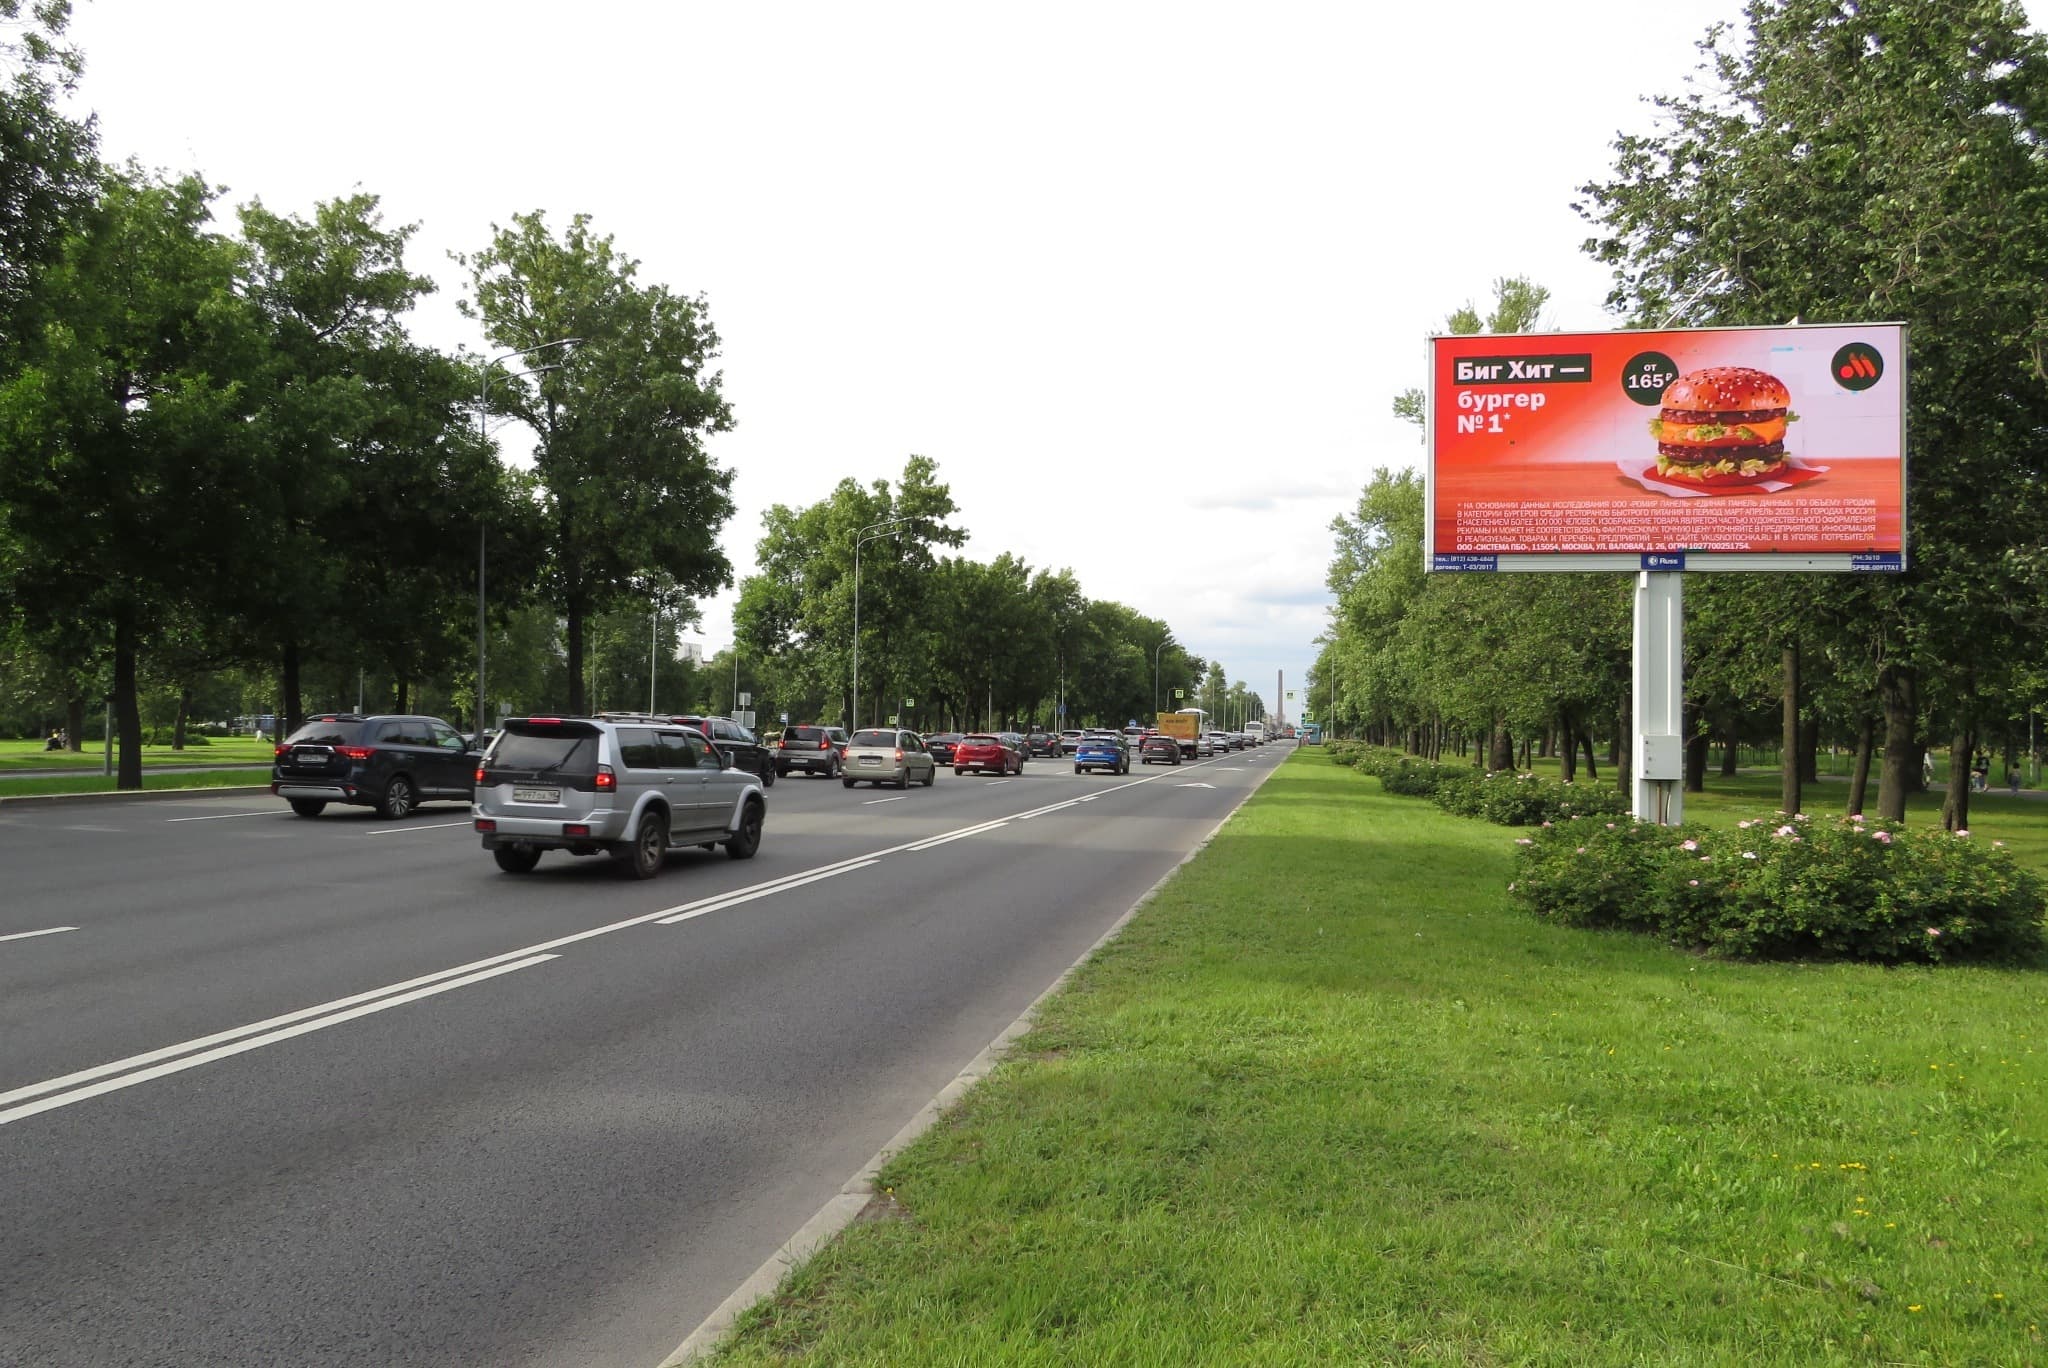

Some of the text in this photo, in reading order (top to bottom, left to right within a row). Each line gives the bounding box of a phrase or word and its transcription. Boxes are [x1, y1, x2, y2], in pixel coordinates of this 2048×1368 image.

[1457, 361, 1503, 380] Биг
[1507, 360, 1555, 379] Хит
[1643, 363, 1658, 372] от
[1457, 390, 1546, 412] бургер
[1712, 524, 1753, 532] УТОЧНЯЙТЕ
[1599, 534, 1650, 542] ПРЕДПРИЯТИЙ
[1676, 533, 1698, 541] САЙТЕ
[1562, 543, 1594, 551] МОСКВА,
[1596, 543, 1607, 551] УЛ.
[1659, 557, 1679, 565] Russ
